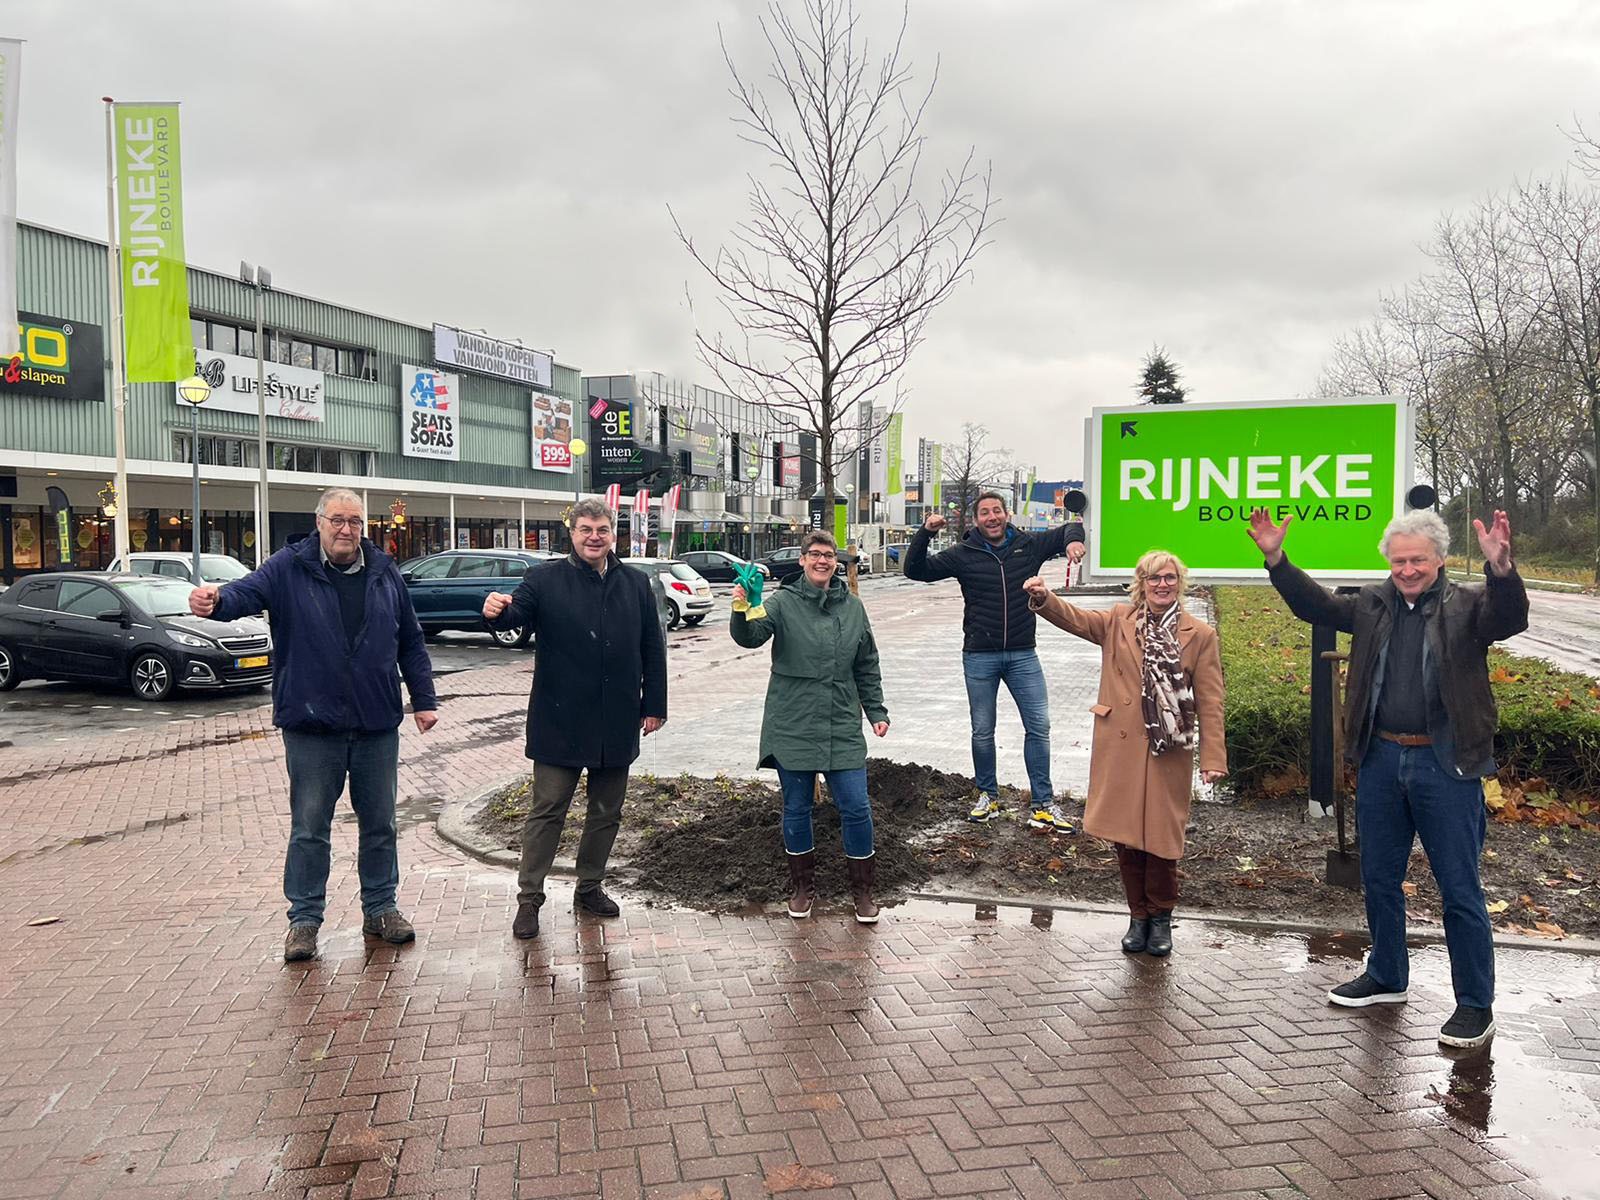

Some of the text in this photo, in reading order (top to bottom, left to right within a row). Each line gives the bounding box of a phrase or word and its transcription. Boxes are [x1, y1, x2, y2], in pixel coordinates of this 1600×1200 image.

[157, 116, 172, 231] BOULEVARD
[125, 117, 165, 287] RIJNEKE
[456, 333, 503, 358] VANDAAG
[21, 367, 65, 386] slapen
[453, 349, 539, 382] VANAVOND ZITTEN
[412, 410, 453, 431] SEATS
[410, 428, 454, 448] SOFAS
[1119, 454, 1373, 511] RIJNEKE
